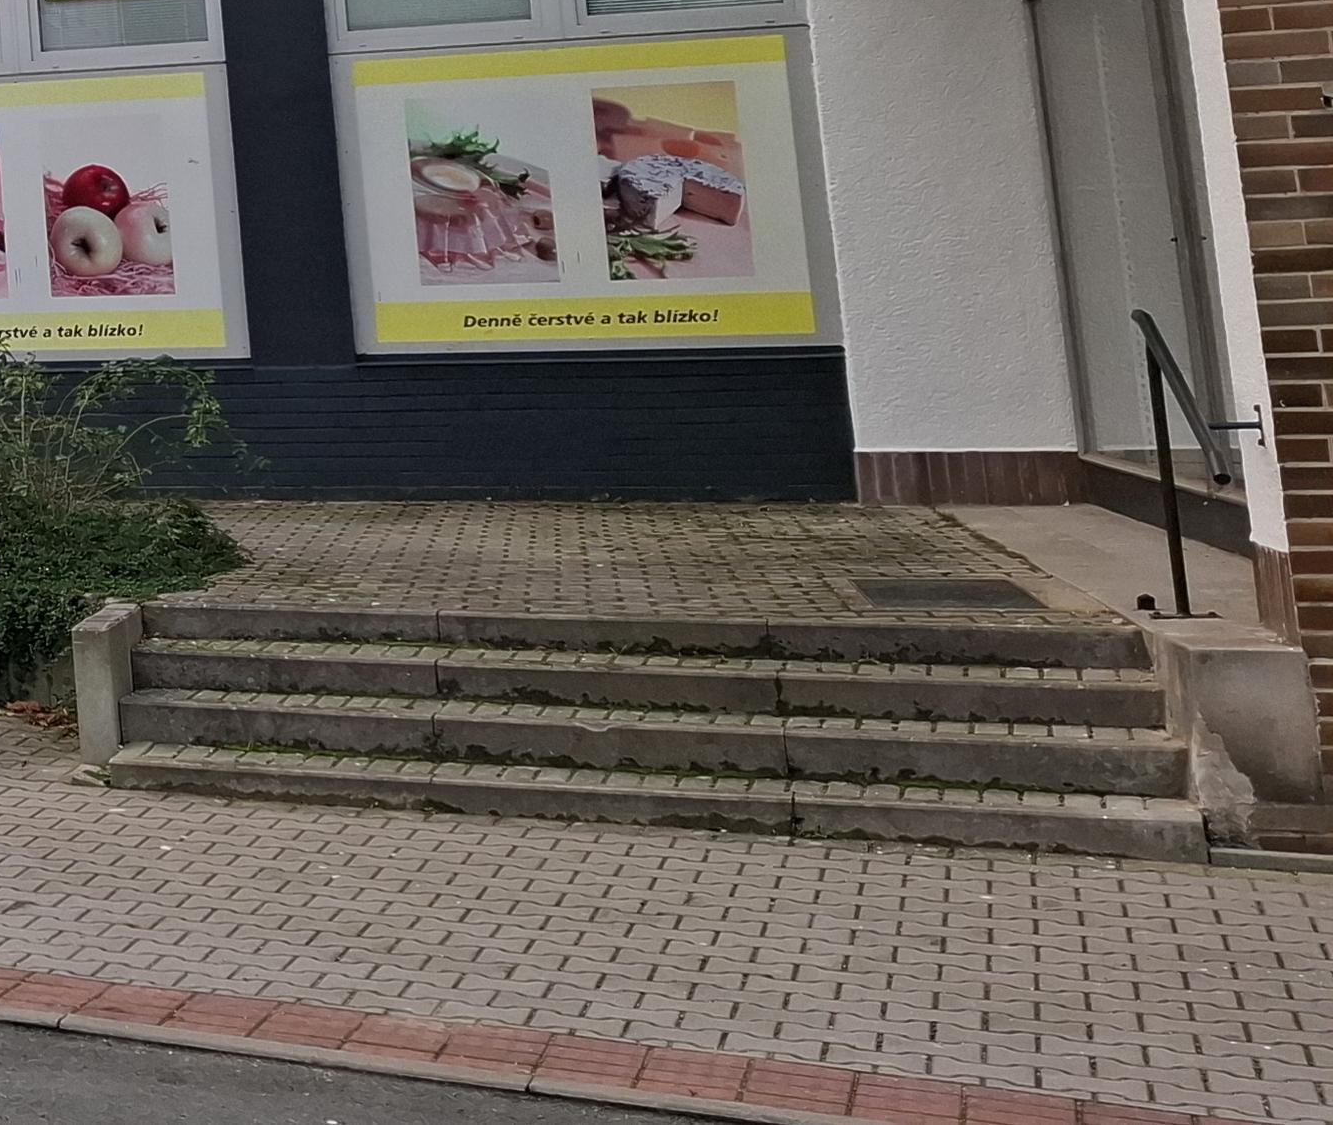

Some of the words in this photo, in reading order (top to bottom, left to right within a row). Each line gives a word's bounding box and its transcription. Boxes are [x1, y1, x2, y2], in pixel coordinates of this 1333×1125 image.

[463, 314, 522, 328] Denně
[528, 312, 595, 326] čerstvé
[600, 314, 611, 325] a
[617, 311, 648, 325] tak
[653, 309, 719, 324] blízko!
[43, 328, 51, 338] a
[57, 324, 83, 338] tak
[88, 323, 143, 337] blízko!
